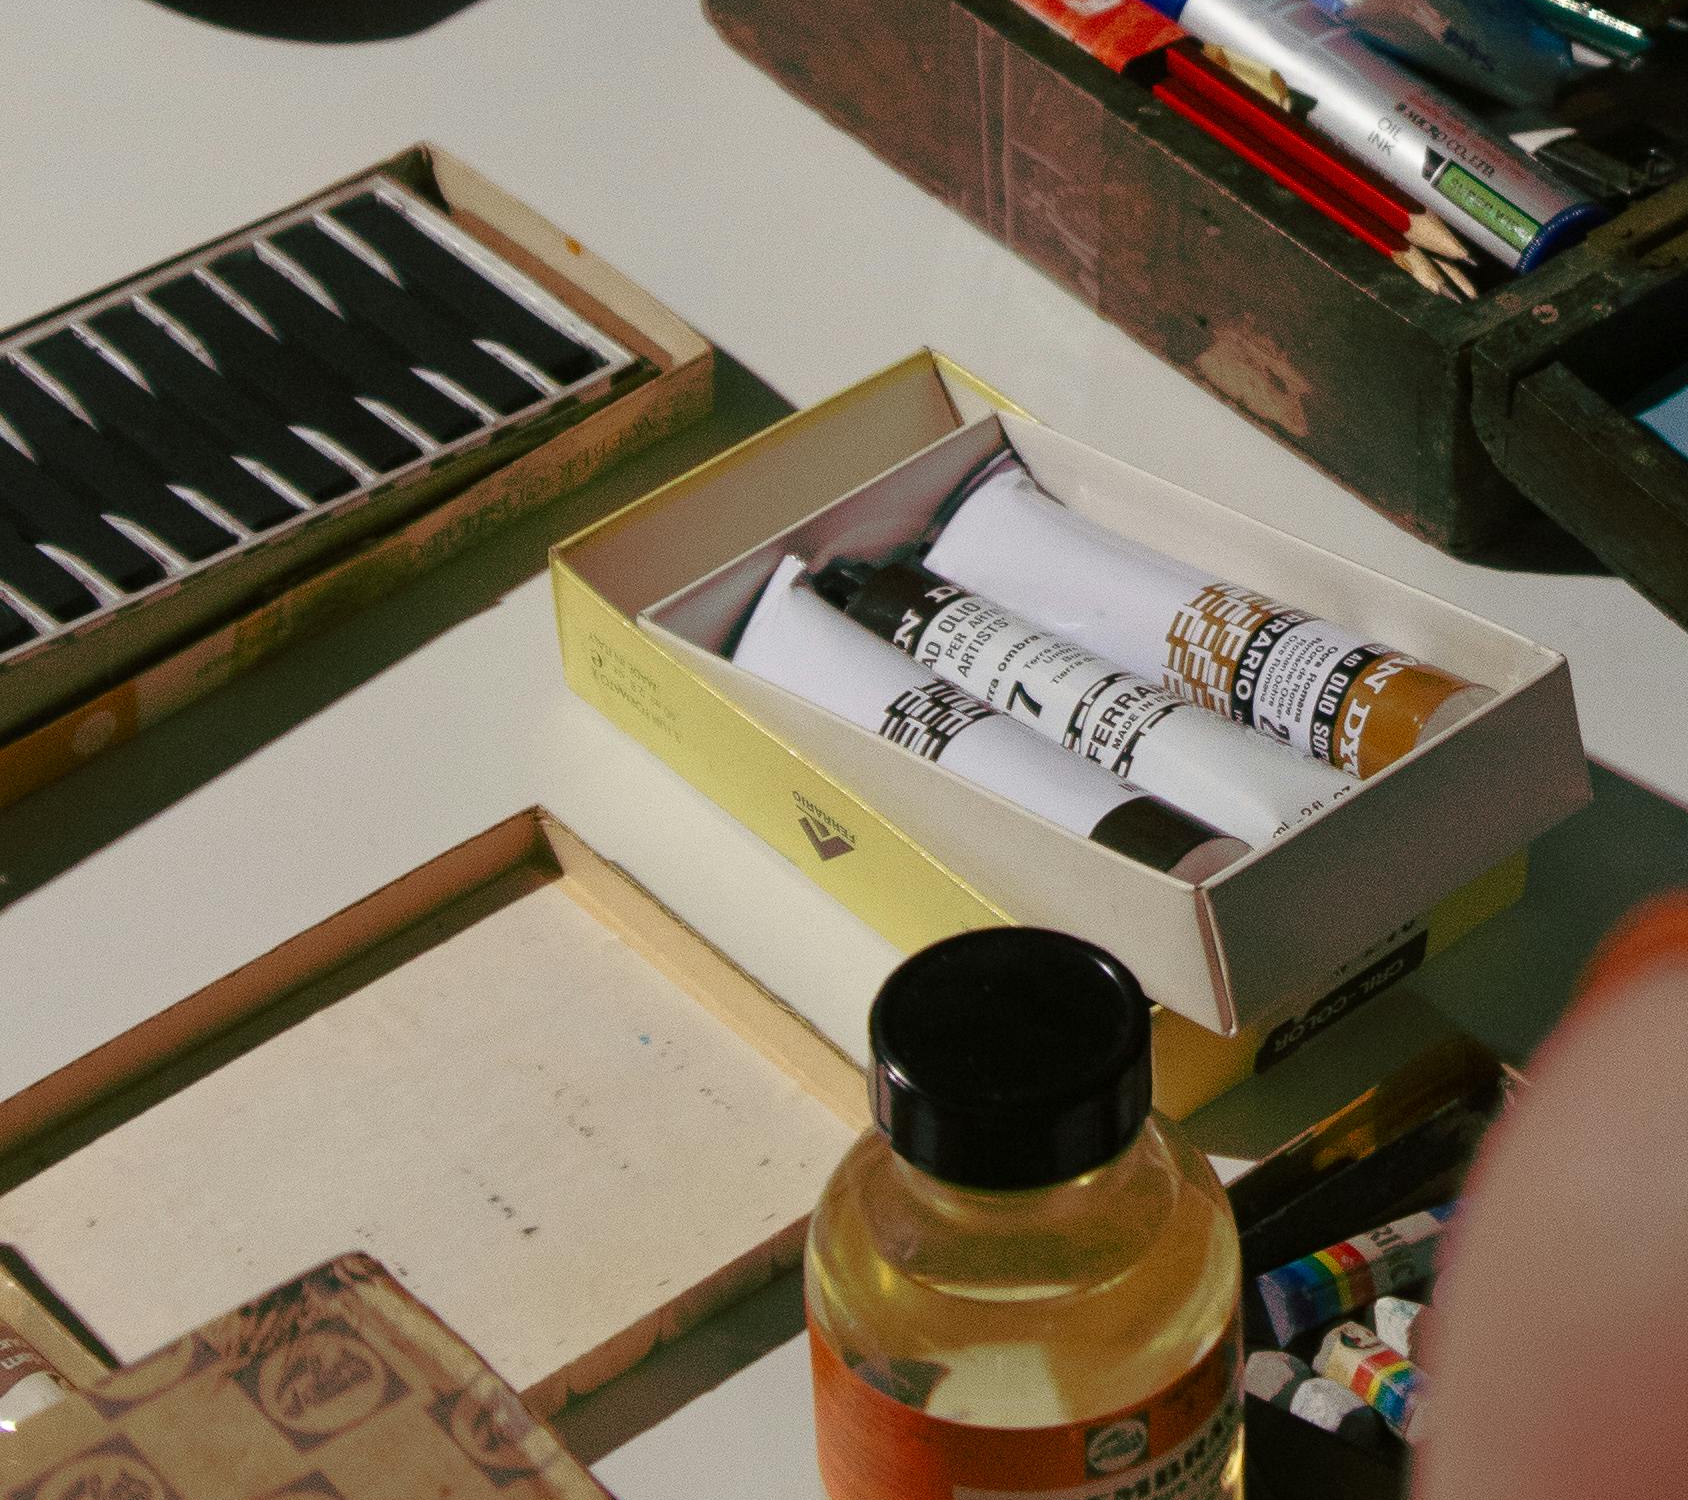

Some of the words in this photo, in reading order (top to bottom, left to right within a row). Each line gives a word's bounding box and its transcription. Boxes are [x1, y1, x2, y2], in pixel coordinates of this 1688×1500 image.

[1367, 130, 1396, 156] INK
[921, 640, 942, 670] AD
[938, 601, 982, 636] OLIO
[945, 631, 968, 660] PER
[997, 634, 1041, 673] ombra
[1235, 612, 1304, 700] RRARIO
[1296, 667, 1306, 681] de
[1342, 651, 1364, 668] AD
[1006, 679, 1043, 719] 7
[1260, 657, 1281, 703] Romana
[1268, 674, 1283, 707] Ochre
[1294, 672, 1318, 723] Romana
[1318, 672, 1350, 716] OLIO
[1276, 687, 1289, 720] Ocker
[1285, 683, 1301, 717] Rome
[1111, 711, 1142, 752] MADE
[1137, 694, 1156, 713] IN
[791, 789, 857, 845] FERRARIO
